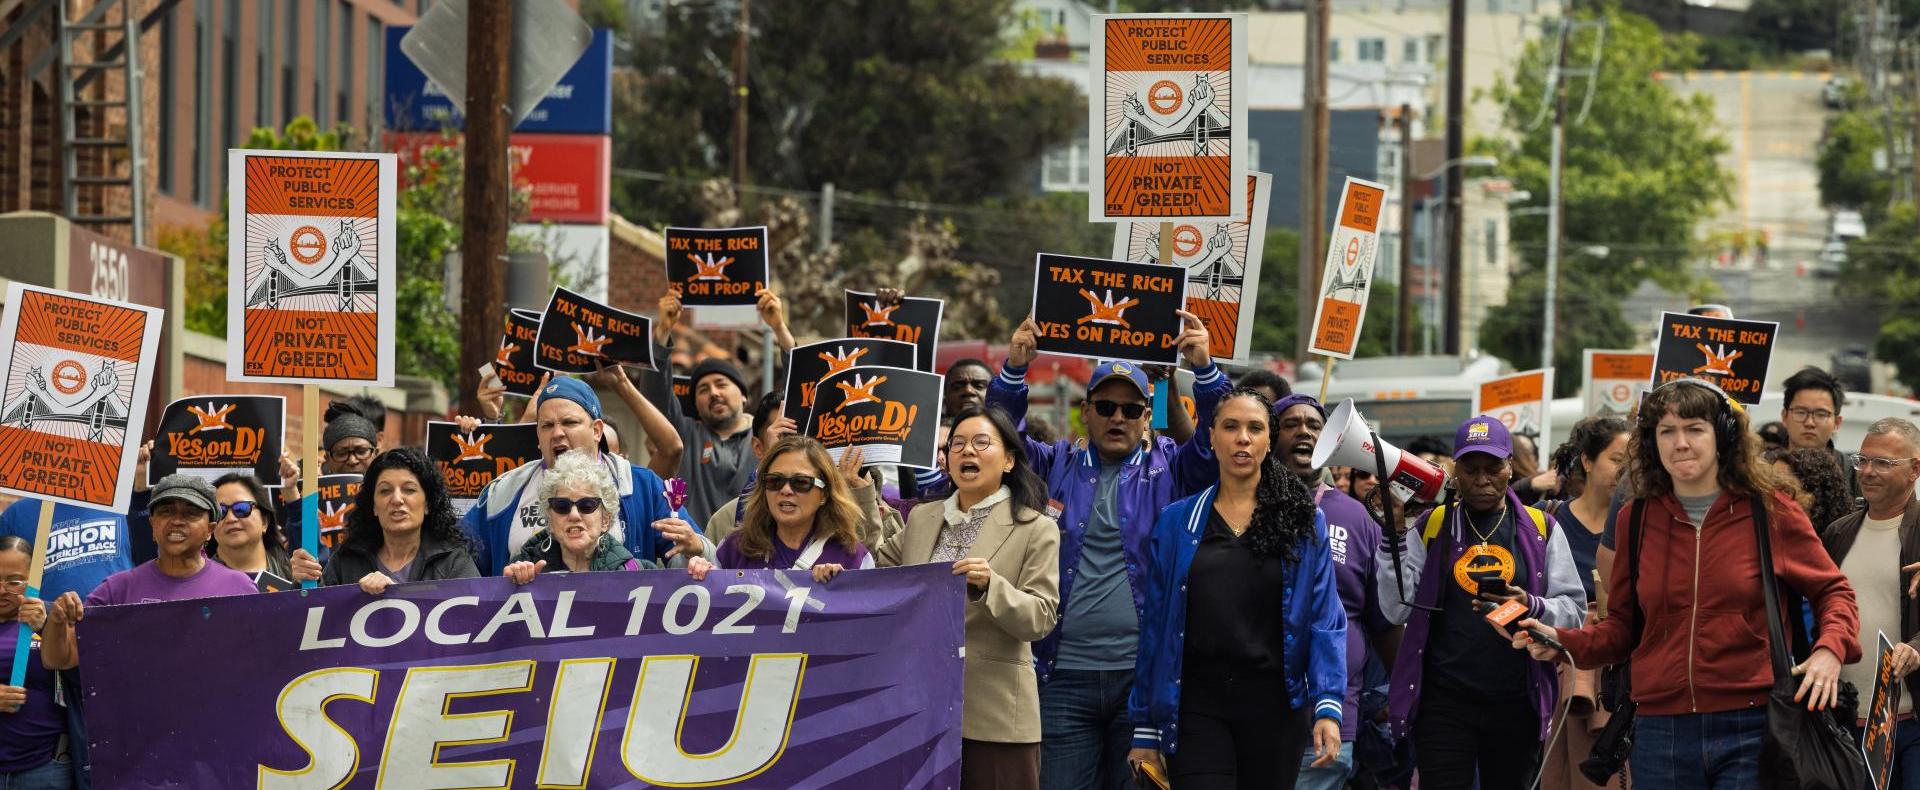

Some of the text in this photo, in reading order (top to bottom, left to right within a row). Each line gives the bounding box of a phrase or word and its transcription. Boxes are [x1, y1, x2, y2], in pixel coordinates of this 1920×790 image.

[1128, 26, 1188, 38] PROTECT
[1142, 40, 1188, 50] PUBLIC
[270, 165, 332, 179] PROTECT
[1153, 162, 1183, 174] NOT
[284, 181, 332, 194] PUBLIC
[1132, 176, 1203, 190] PRIVATE
[1136, 192, 1199, 207] GREED!
[670, 237, 690, 250] TAX
[694, 238, 722, 251] THE
[90, 241, 128, 303] 2550
[1050, 266, 1085, 284] TAX
[1091, 270, 1127, 288] THE
[688, 282, 710, 295] ON
[714, 281, 750, 295] PROP
[44, 301, 102, 322] PROTECT
[556, 298, 578, 318] TAX
[580, 308, 605, 328] THE
[54, 316, 101, 334] PUBLIC
[296, 317, 326, 330] NOT
[274, 332, 348, 350] PRIVATE
[516, 326, 538, 342] RIC
[1040, 321, 1173, 350] YES ON PROP D
[1671, 323, 1702, 339] TAX
[1707, 327, 1736, 343] THE
[277, 350, 344, 368] GREED!
[540, 342, 564, 362] YES
[246, 361, 264, 370] FIX
[500, 367, 536, 384] PROP
[1720, 377, 1750, 392] PROP
[1752, 380, 1760, 392] D
[816, 400, 918, 439] Yes on D!
[45, 440, 74, 454] NOT
[167, 426, 265, 456] Yes on D!
[22, 450, 92, 476] PRIVATE
[22, 467, 86, 490] GREED!
[469, 470, 492, 486] on
[46, 525, 116, 554] UNION
[45, 541, 116, 564] STRIKES BACK
[299, 584, 811, 650] LOCAL 1021
[1874, 686, 1886, 717] THE
[258, 653, 810, 790] SEIU
[1866, 718, 1878, 752] TAX
